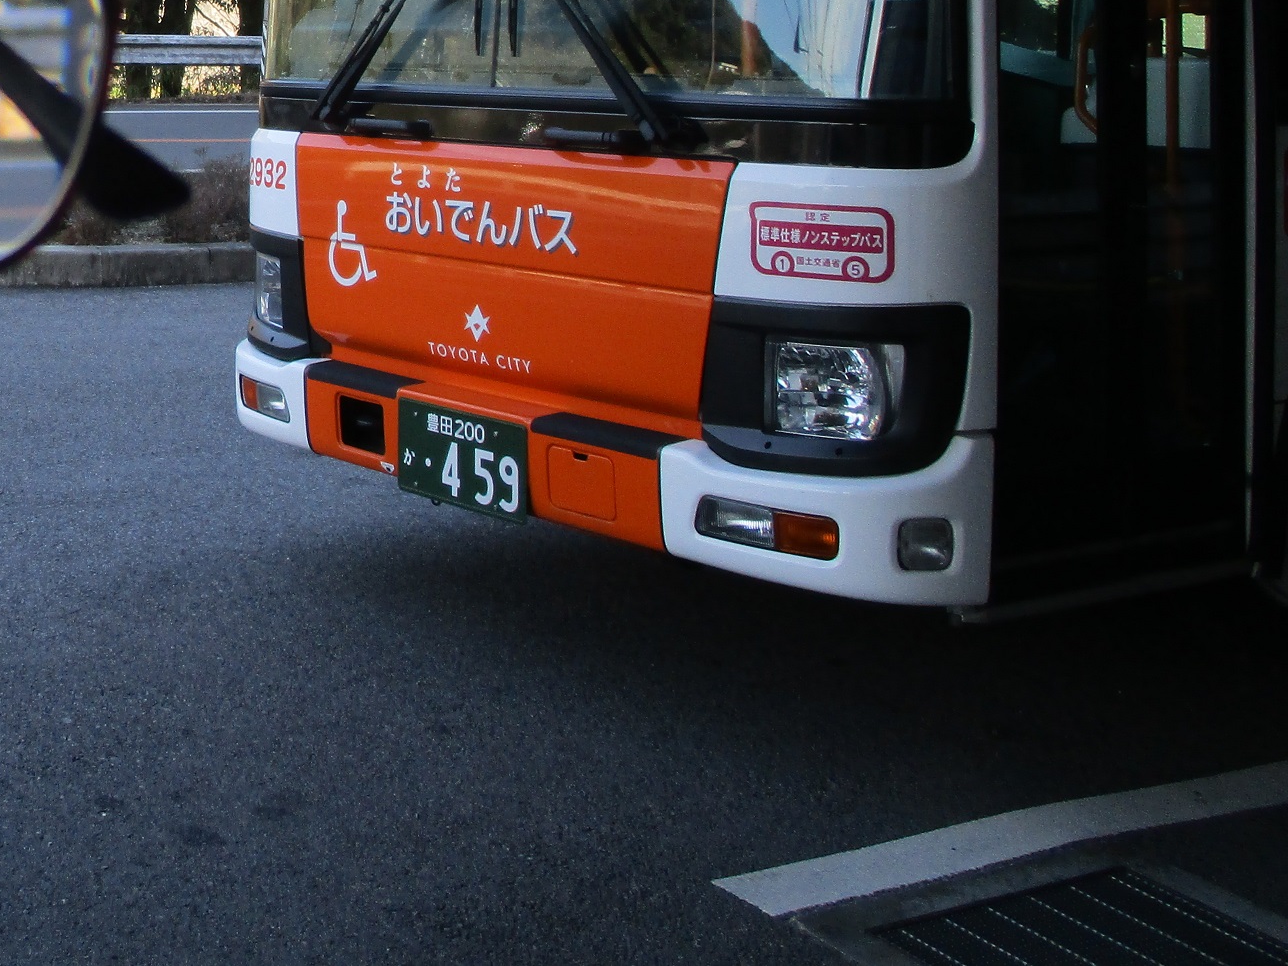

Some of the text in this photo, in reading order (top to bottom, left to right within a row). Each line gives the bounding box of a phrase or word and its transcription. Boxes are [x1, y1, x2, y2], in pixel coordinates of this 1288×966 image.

[390, 162, 462, 193] とよた
[385, 191, 579, 257] おいでんバス
[805, 212, 830, 222] 認定
[760, 226, 882, 247] 標準仕様ノンステップバス
[796, 256, 841, 268] 国土交通省
[851, 265, 860, 276] 5
[427, 340, 531, 374] TOYOTA CITY
